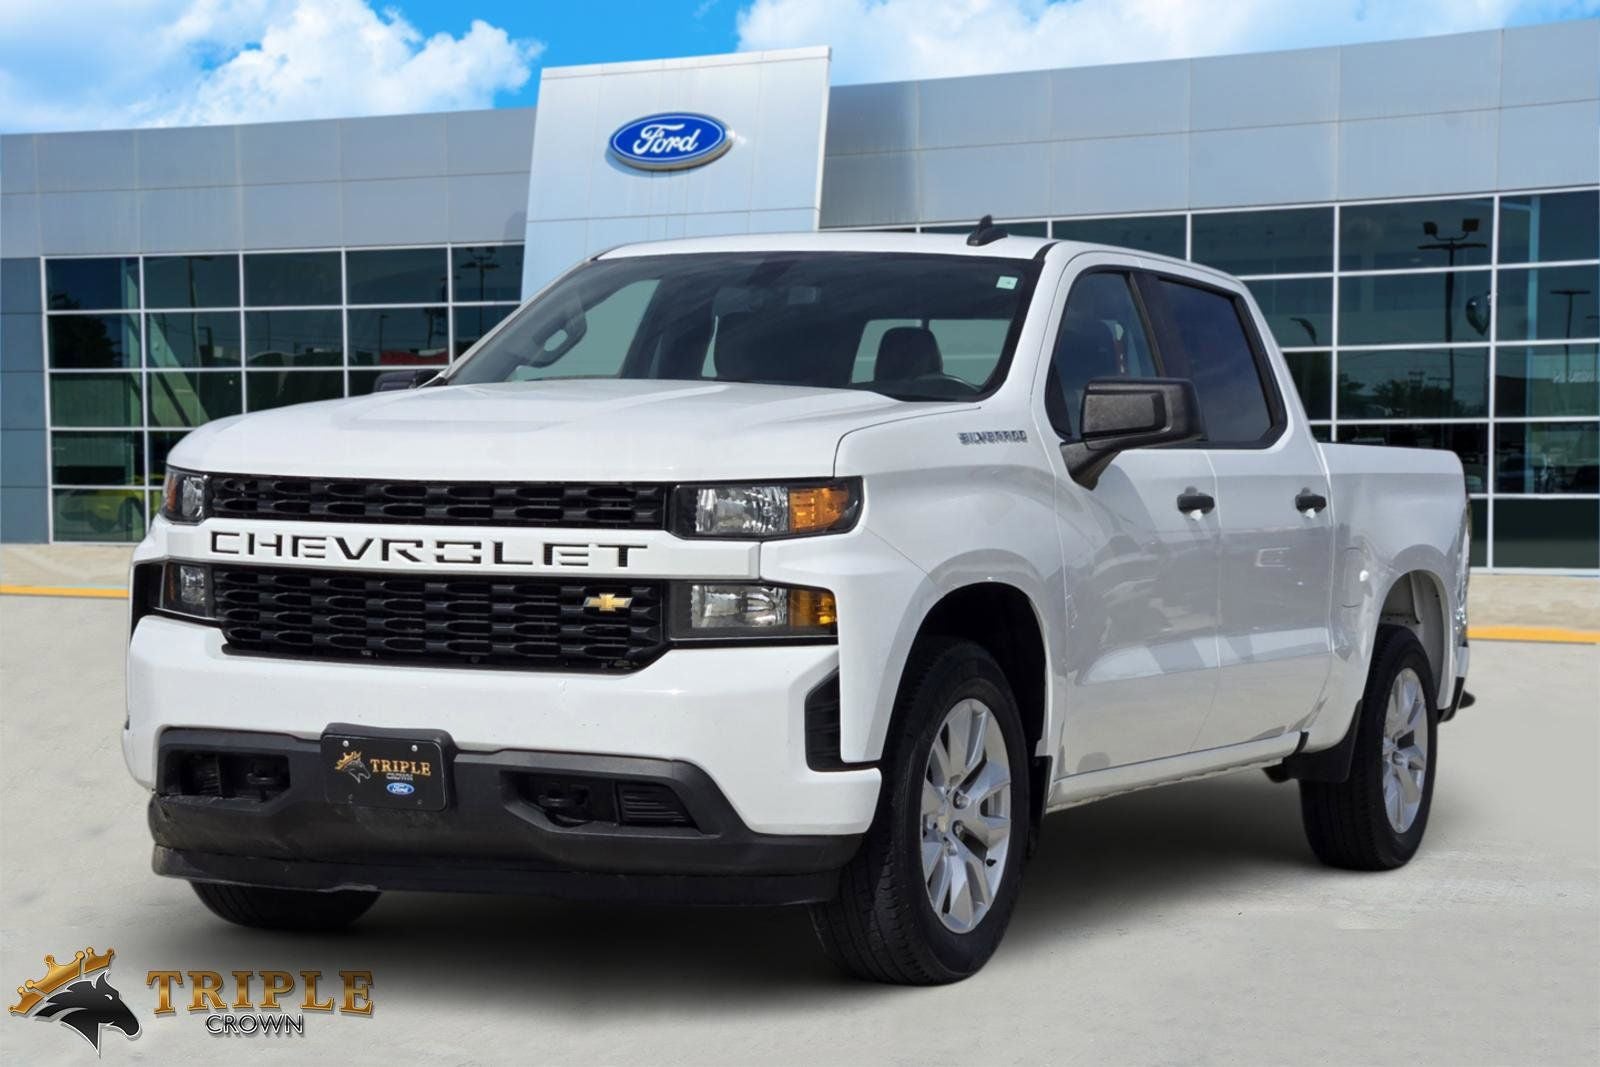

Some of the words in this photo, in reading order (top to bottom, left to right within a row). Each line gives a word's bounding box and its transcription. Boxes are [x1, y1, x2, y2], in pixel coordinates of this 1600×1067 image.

[633, 123, 701, 155] Ford
[959, 430, 1027, 445] SILVERADO
[211, 531, 648, 568] CHEVROLET
[369, 758, 432, 776] TRIPLE
